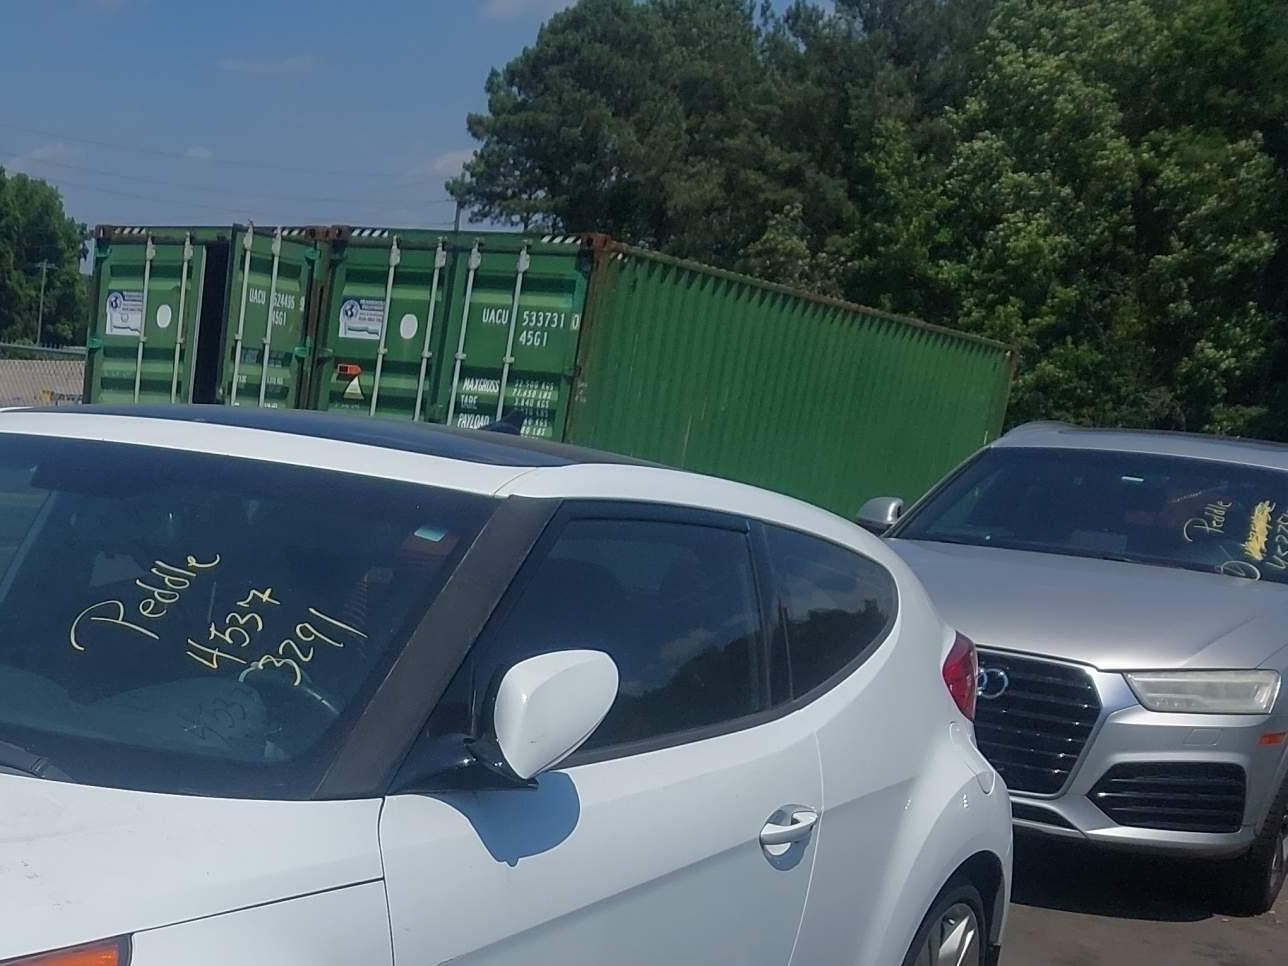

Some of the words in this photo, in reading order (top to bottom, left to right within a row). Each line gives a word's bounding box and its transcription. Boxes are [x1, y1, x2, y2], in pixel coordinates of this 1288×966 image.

[249, 288, 266, 304] UACU
[482, 307, 509, 324] UACU
[522, 311, 565, 328] 533731
[519, 330, 548, 346] 45G1
[460, 395, 478, 410] TARE
[457, 413, 490, 429] PAYLOAD
[70, 553, 220, 651] Peddle
[258, 607, 369, 687] 3291
